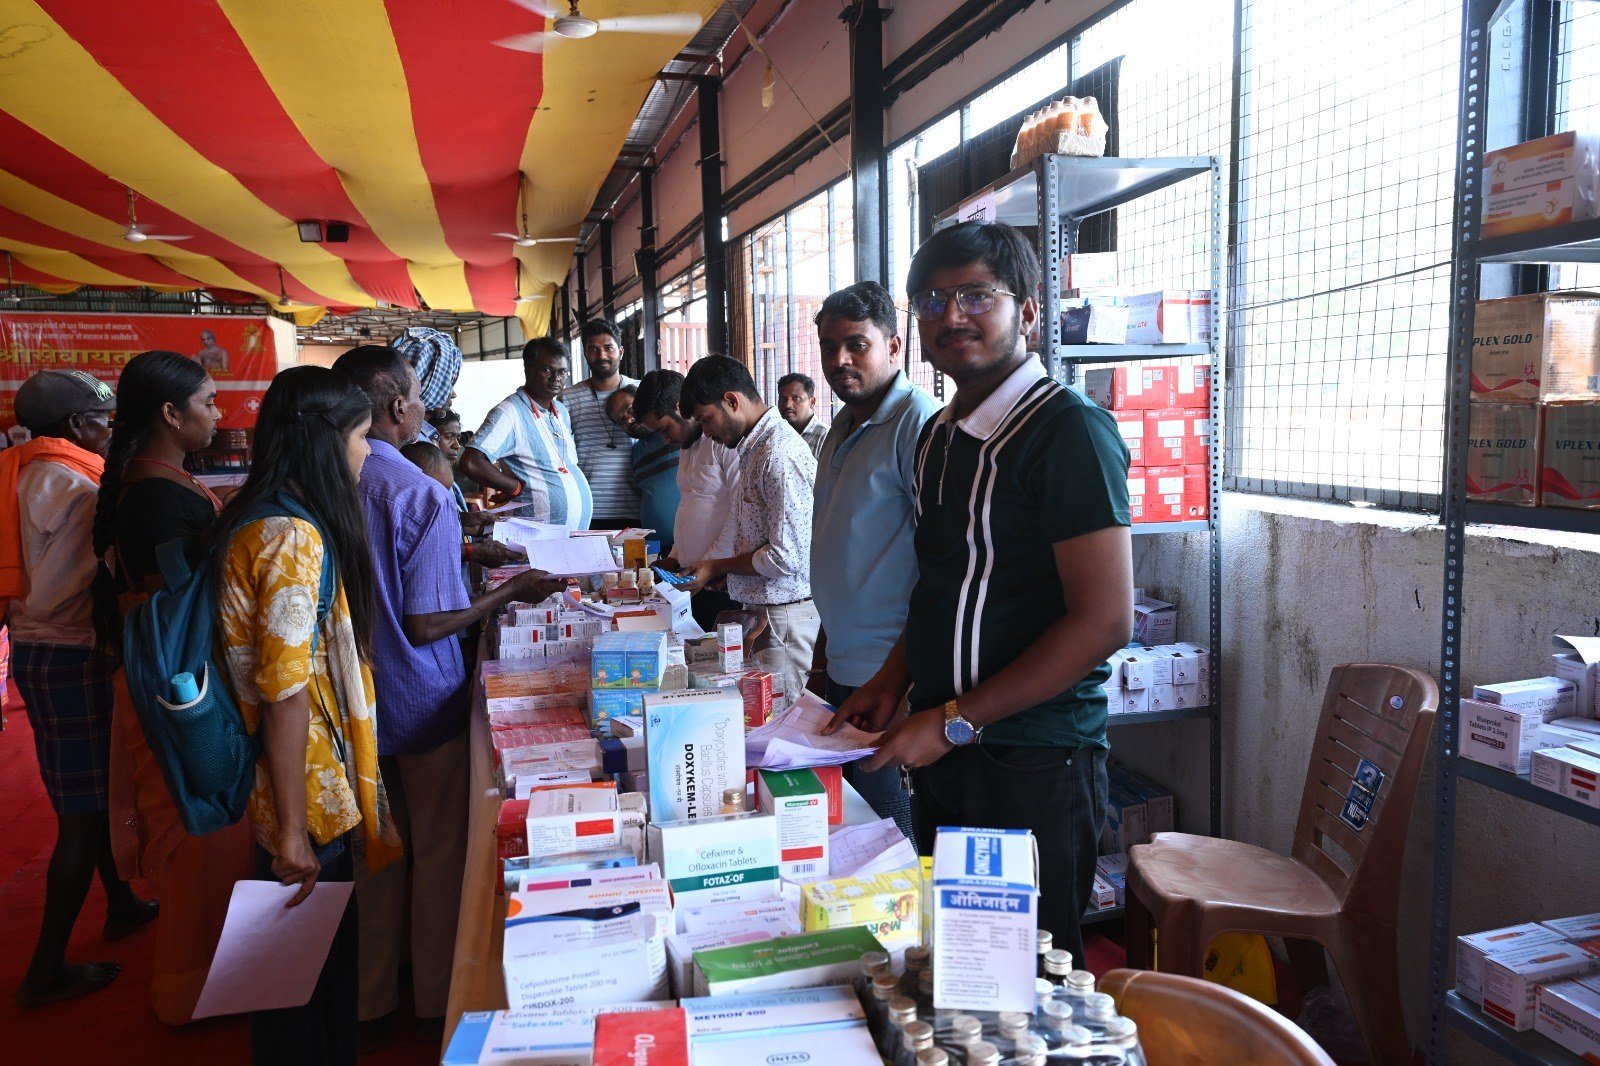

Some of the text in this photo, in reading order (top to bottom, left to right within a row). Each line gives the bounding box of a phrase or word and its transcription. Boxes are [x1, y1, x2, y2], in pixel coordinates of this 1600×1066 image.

[1472, 333, 1533, 347] PLEX GOLD
[1467, 438, 1527, 449] PLEX GOLD
[1555, 439, 1594, 451] VPLEX
[1469, 720, 1487, 731] Tablets
[1476, 715, 1502, 728] Bisoprolol
[700, 744, 714, 817] Bacillus Capsules
[621, 817, 638, 825] ipla
[700, 846, 744, 860] Cefixime &
[688, 857, 757, 872] Ofloxacin Tablets
[703, 873, 745, 887] FOTAZ-OF
[949, 891, 1020, 912] ओनिजाईम
[747, 959, 764, 969] 100
[520, 969, 600, 990] Cefpodoxime Proxetil
[521, 987, 562, 1001] Dispersible
[590, 979, 604, 988] 200
[606, 978, 618, 986] mg
[522, 996, 575, 1010] CISDOX-200
[694, 1011, 743, 1021] METRON
[771, 1054, 806, 1063] INTAS
